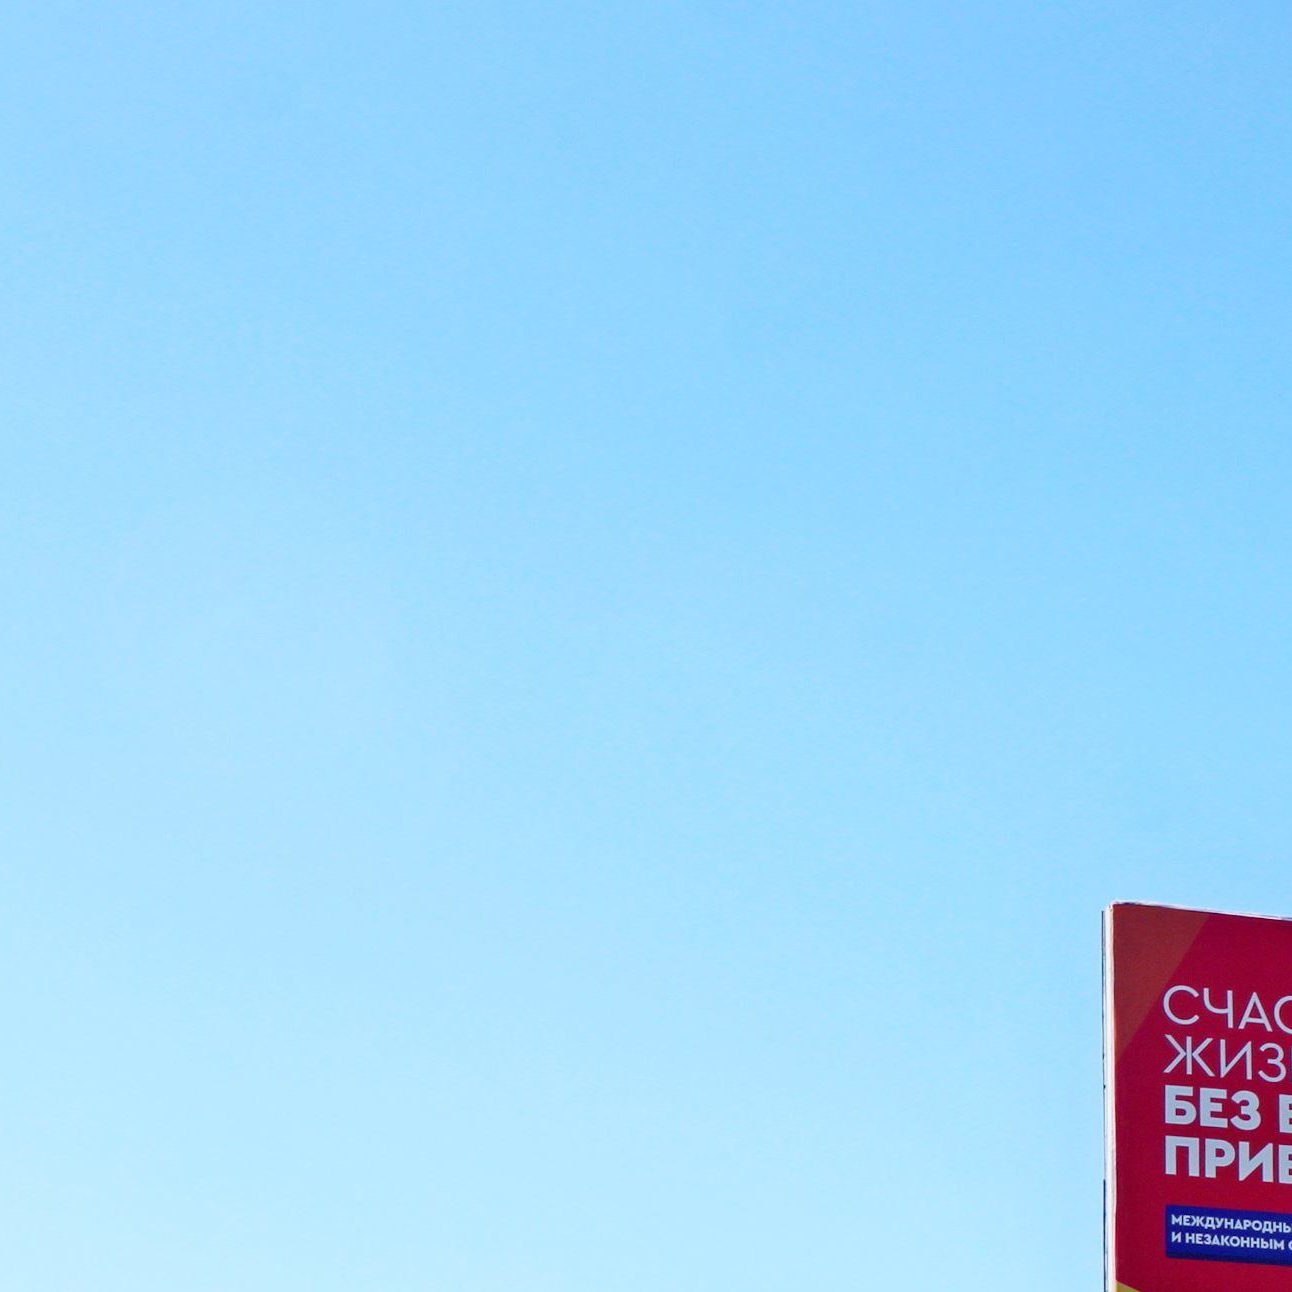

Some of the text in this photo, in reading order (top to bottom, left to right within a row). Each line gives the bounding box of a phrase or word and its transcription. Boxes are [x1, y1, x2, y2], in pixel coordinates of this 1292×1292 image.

[1164, 1085, 1261, 1131] БЕЗ
[1170, 1231, 1182, 1244] И
[1185, 1233, 1285, 1251] НЕЗАКОННЫМ
